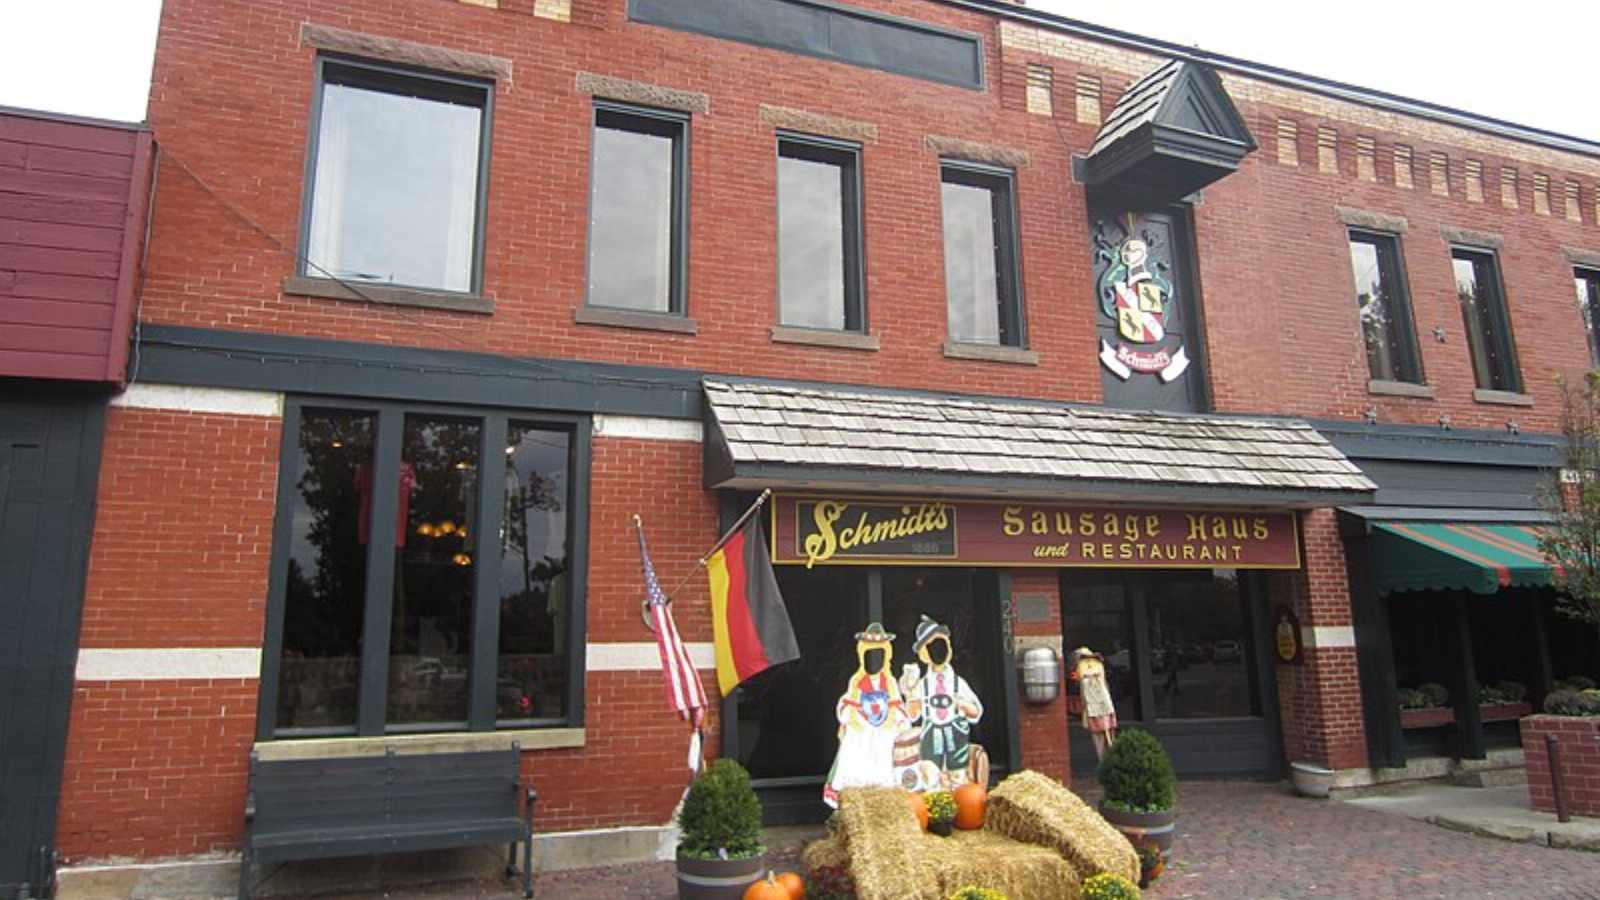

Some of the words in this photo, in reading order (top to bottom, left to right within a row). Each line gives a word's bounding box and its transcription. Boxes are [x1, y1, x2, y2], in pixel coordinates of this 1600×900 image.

[805, 500, 948, 569] Schmidt's
[1003, 506, 1161, 541] Sausage
[1185, 513, 1269, 541] Haus
[1033, 542, 1070, 558] und
[1082, 542, 1242, 560] RESTAURANT
